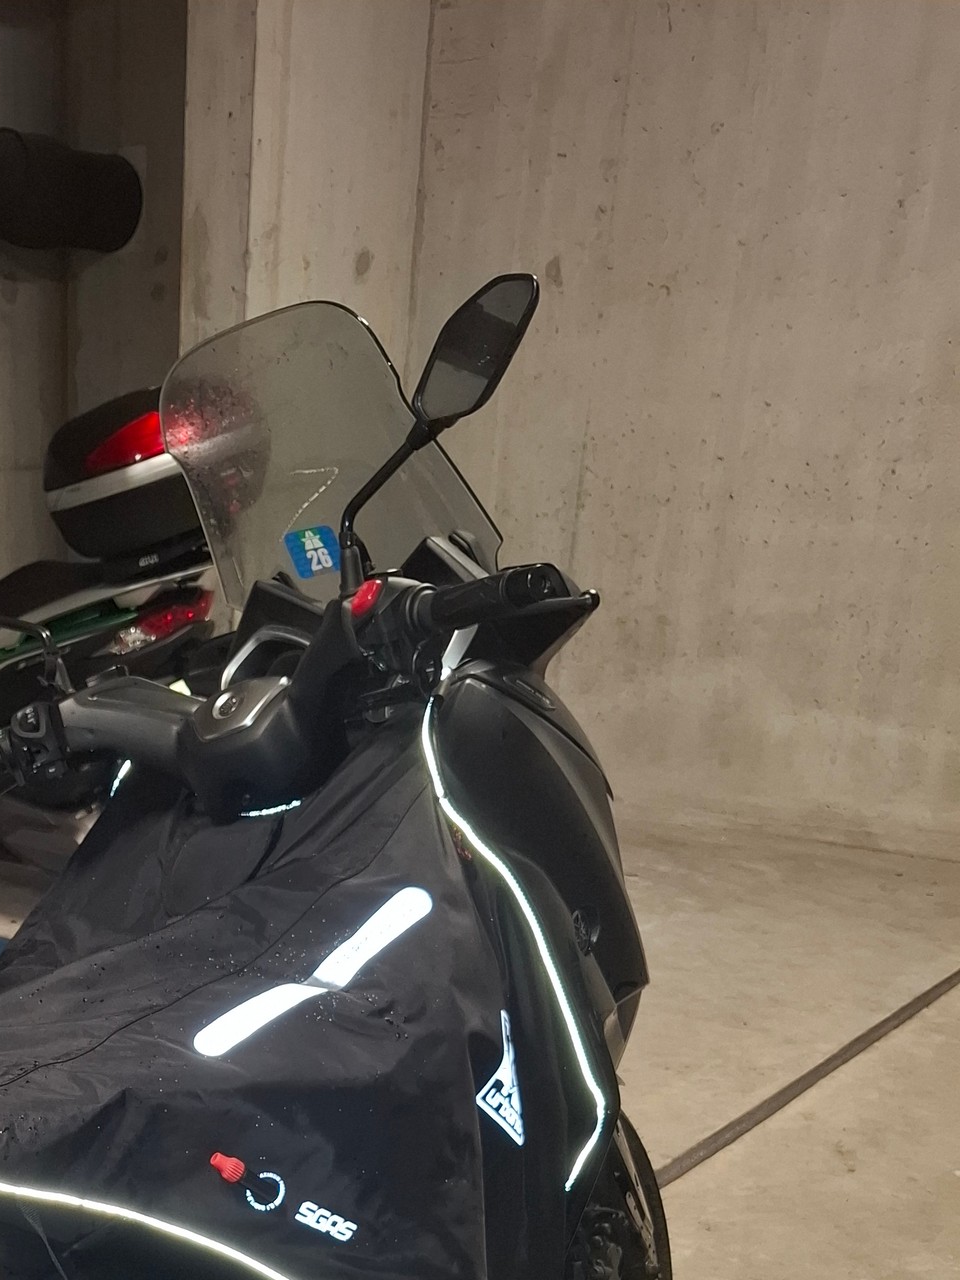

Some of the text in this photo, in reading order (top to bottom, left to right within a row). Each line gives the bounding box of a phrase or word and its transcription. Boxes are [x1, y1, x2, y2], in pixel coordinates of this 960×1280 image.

[306, 548, 333, 572] 26
[485, 1087, 523, 1135] urban
[294, 1200, 358, 1242] SGAS
